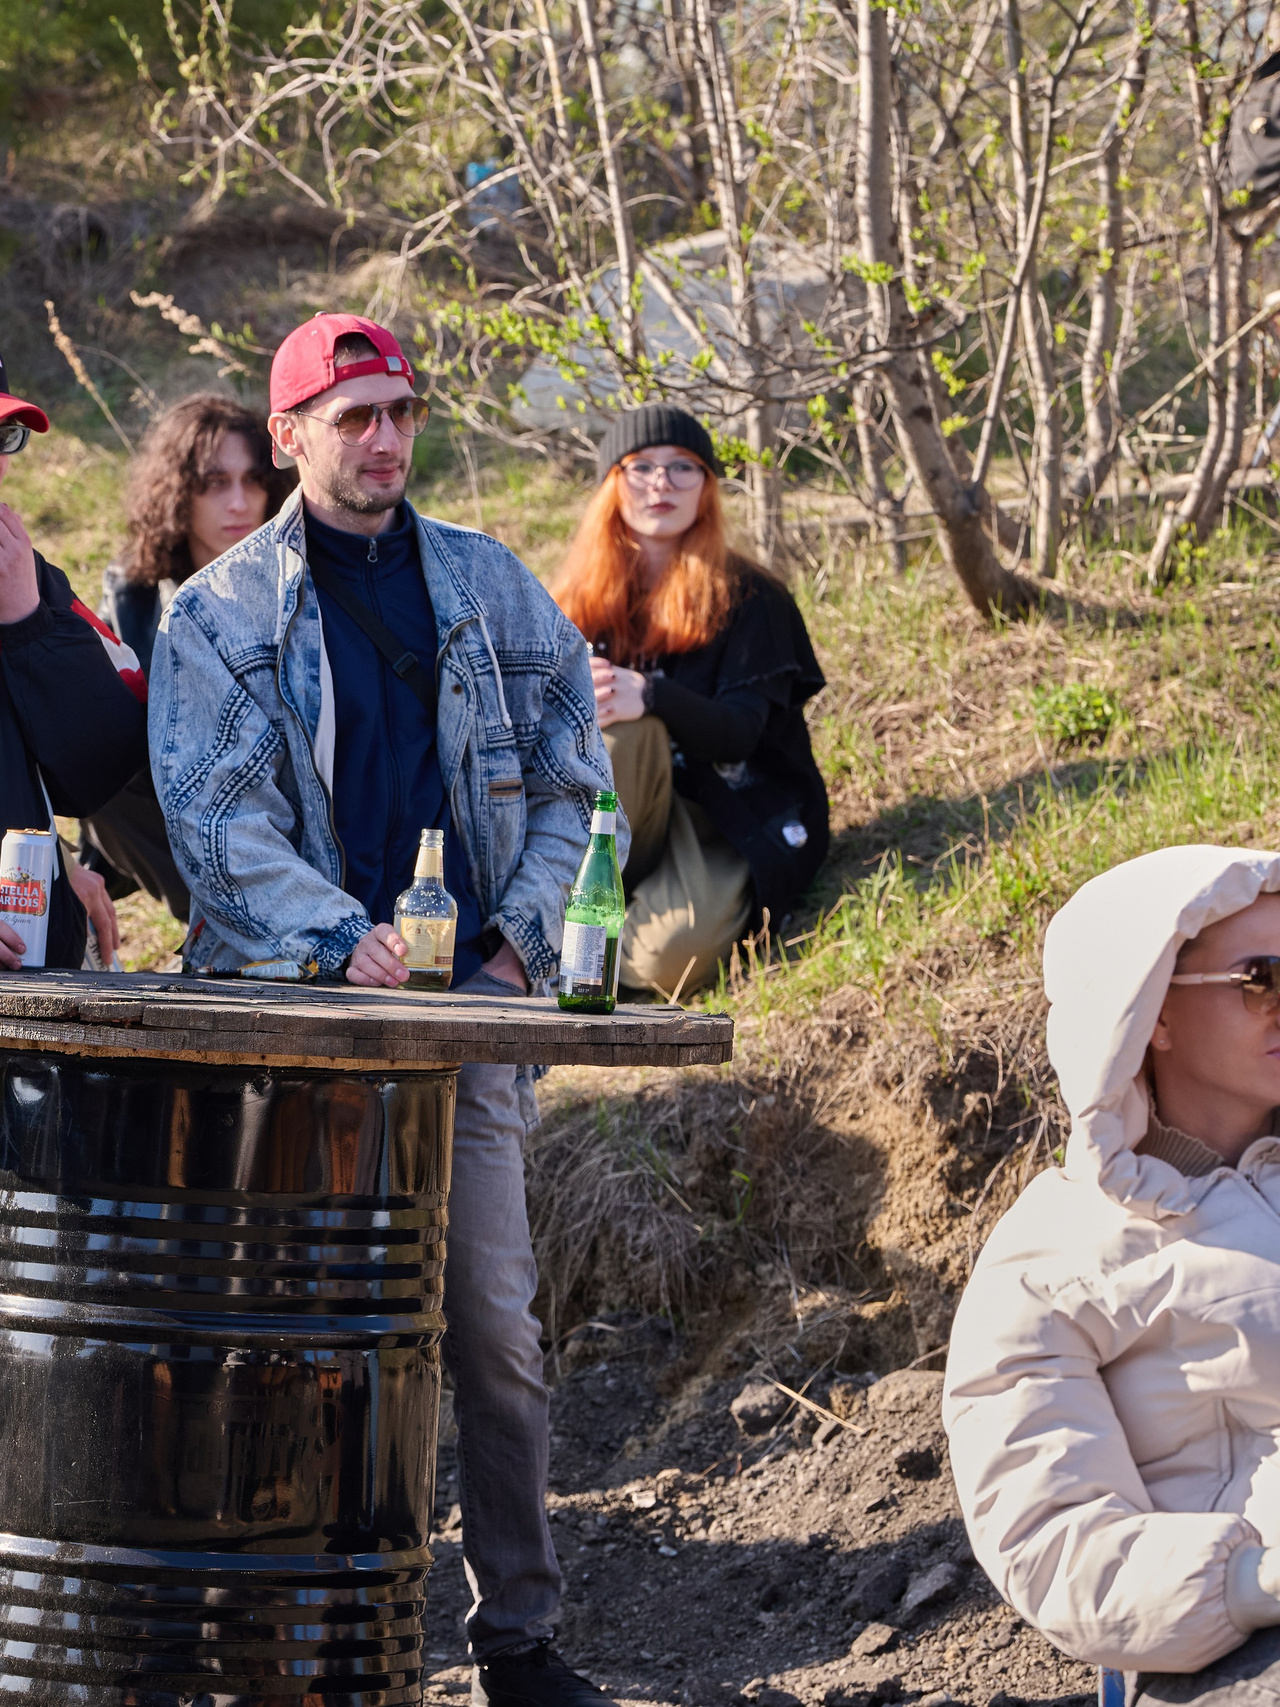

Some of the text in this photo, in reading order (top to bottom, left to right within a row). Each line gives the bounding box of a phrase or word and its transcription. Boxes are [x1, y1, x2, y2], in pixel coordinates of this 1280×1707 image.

[0, 884, 39, 897] STELLA
[0, 896, 39, 908] ARTOIS
[1, 912, 33, 926] Belgium
